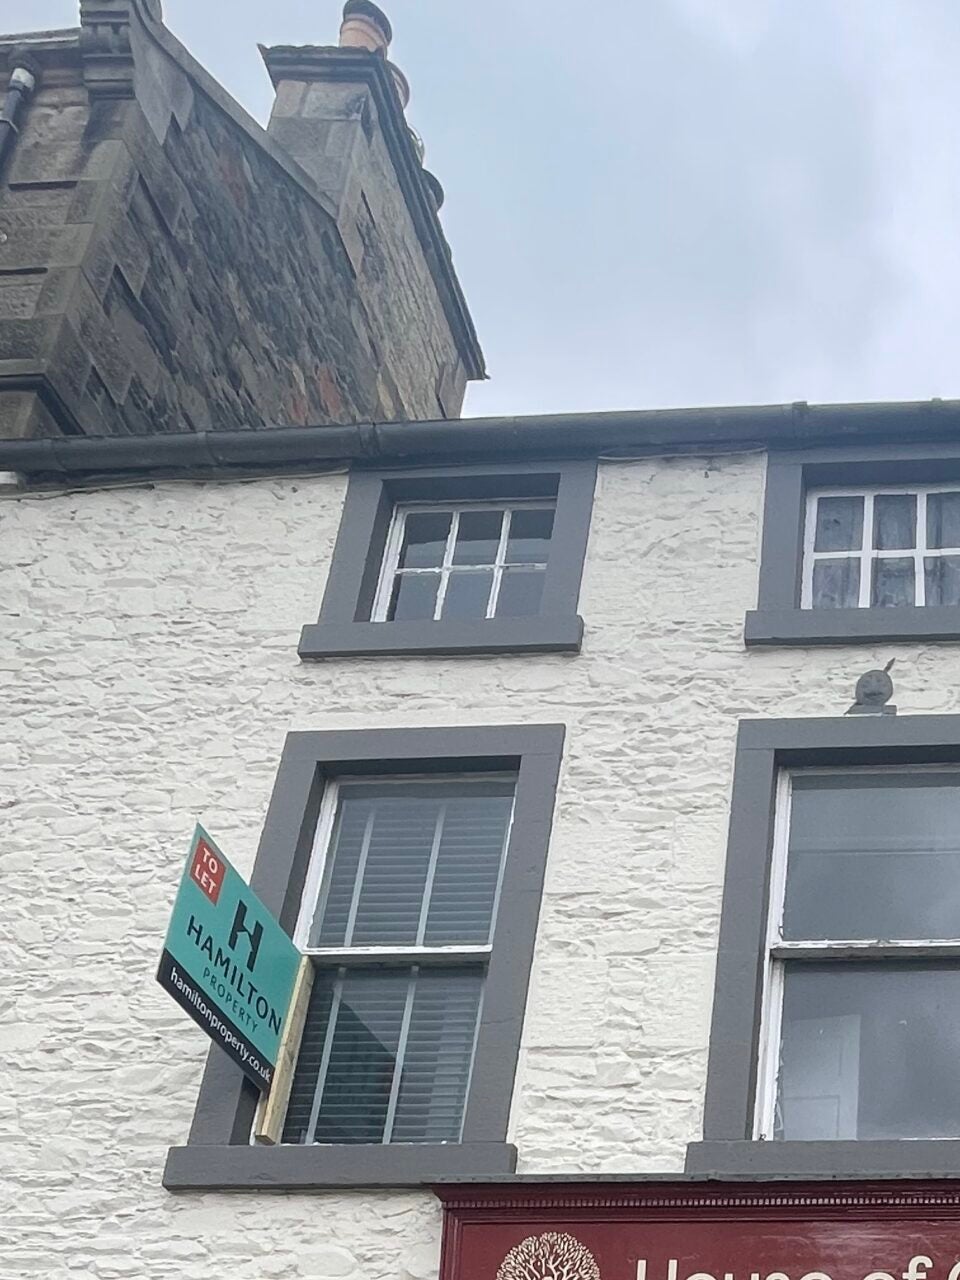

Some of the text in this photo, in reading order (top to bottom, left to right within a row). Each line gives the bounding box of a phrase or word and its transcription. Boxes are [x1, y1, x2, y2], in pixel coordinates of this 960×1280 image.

[194, 863, 217, 895] LET
[203, 847, 219, 874] TO
[186, 914, 283, 1037] HAMILTON
[202, 966, 259, 1034] PROPERTY
[169, 966, 272, 1084] hamiltonproperty.co.uk
